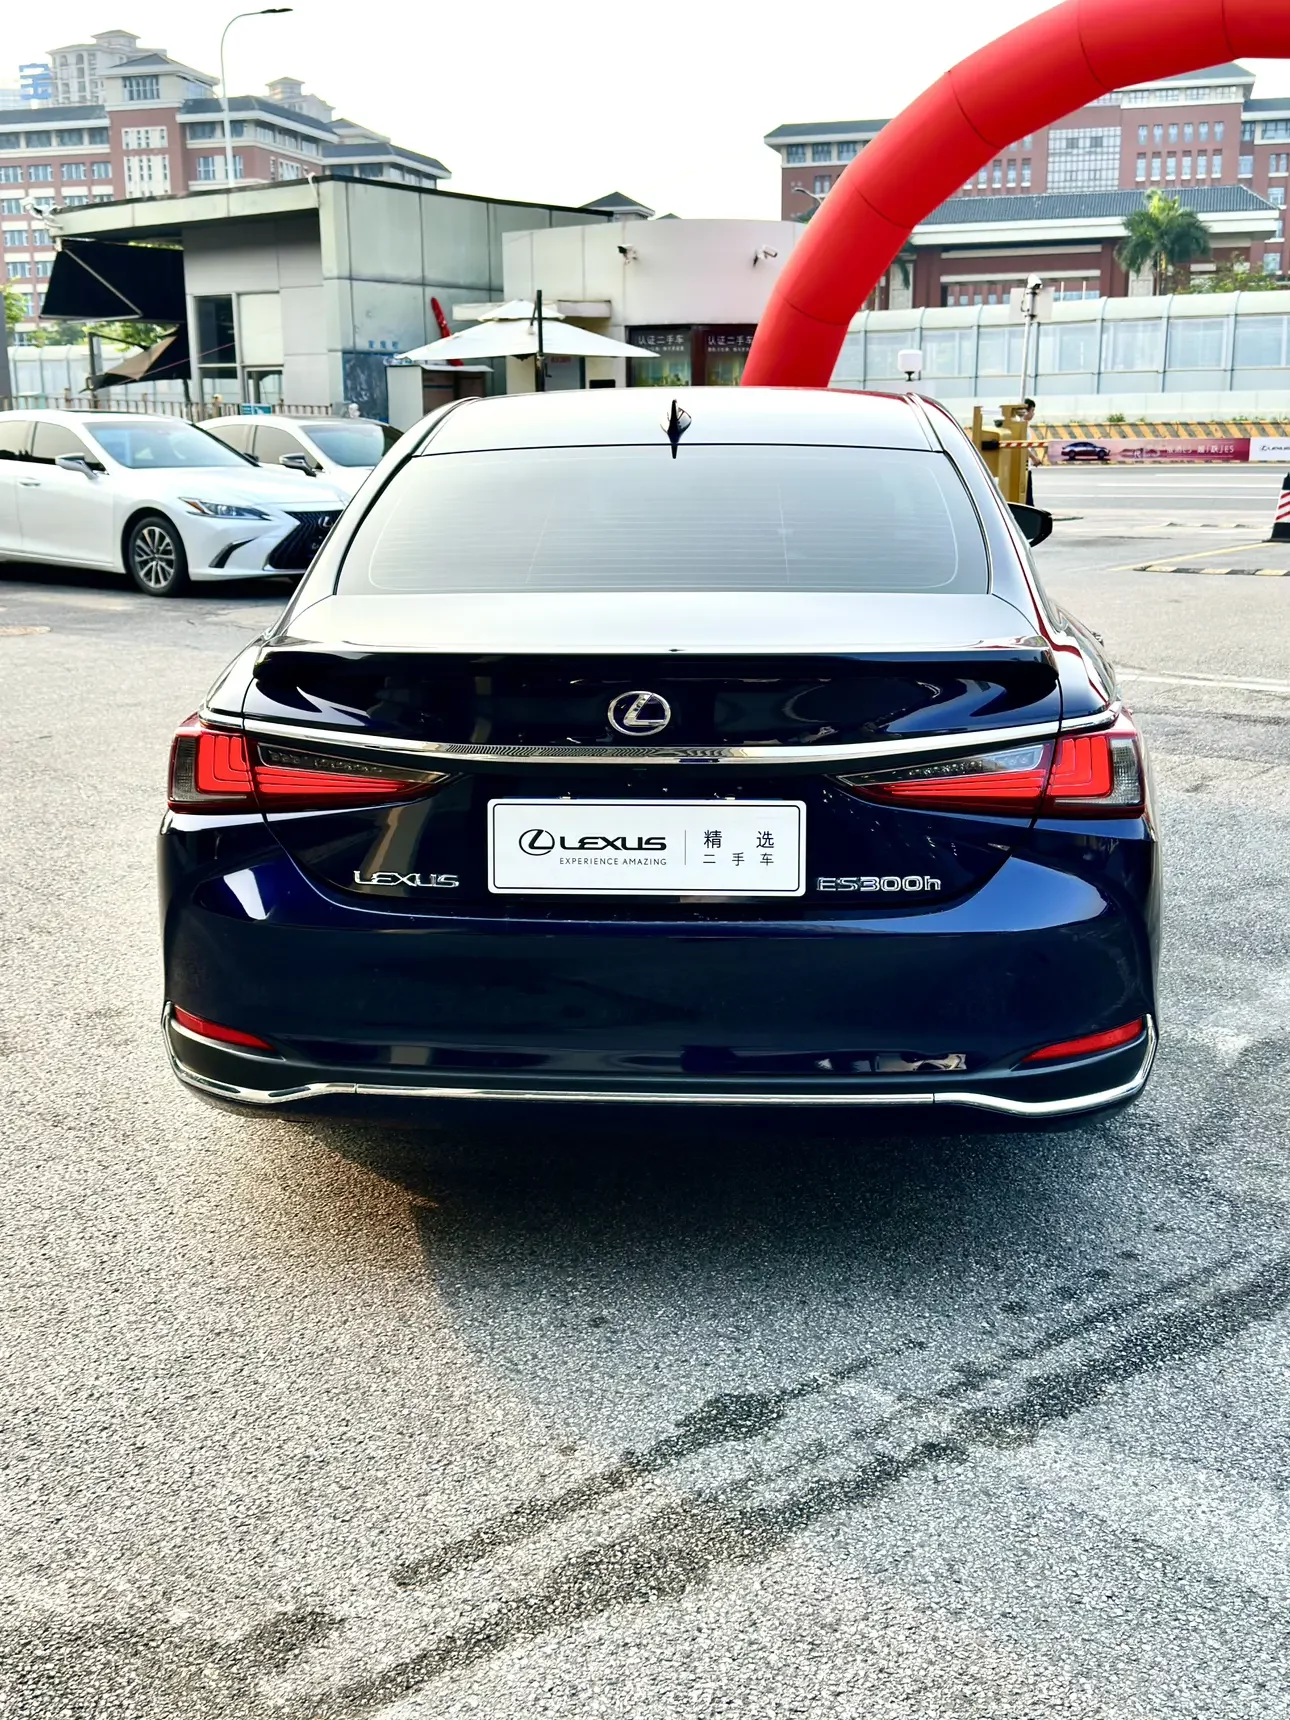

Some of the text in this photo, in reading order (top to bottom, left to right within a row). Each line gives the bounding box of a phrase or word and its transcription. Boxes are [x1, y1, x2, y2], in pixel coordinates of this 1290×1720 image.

[638, 335, 684, 345] 认证二手车
[559, 836, 667, 851] LEXUS
[560, 857, 667, 866] EXPERIENCE AMAZING
[353, 870, 460, 888] LEXUS
[816, 875, 942, 892] ES300h
